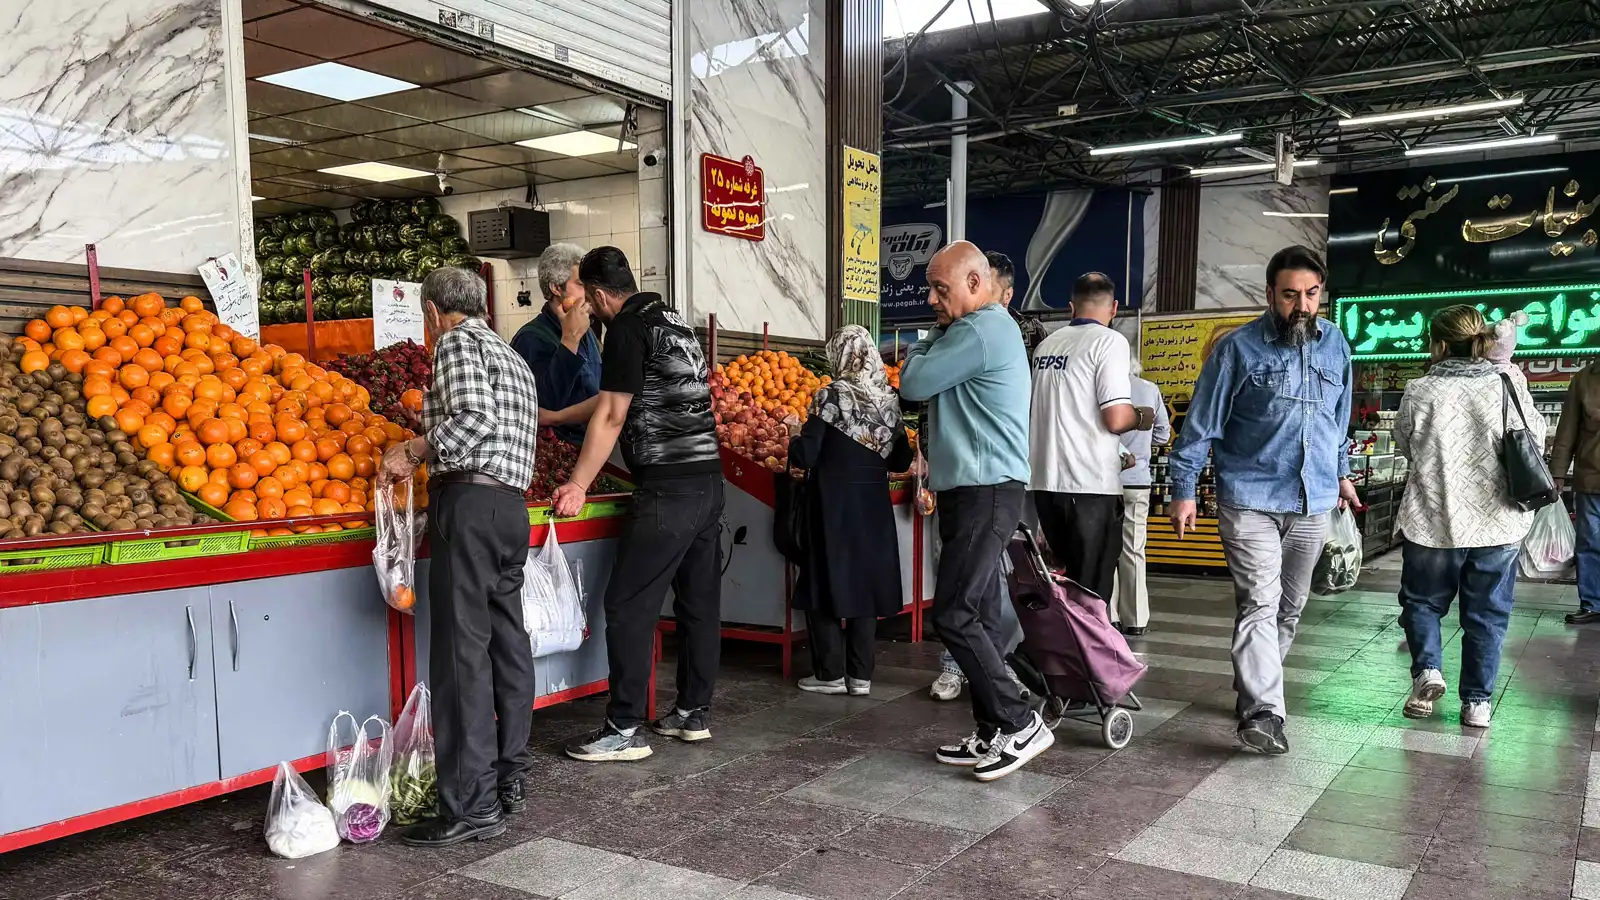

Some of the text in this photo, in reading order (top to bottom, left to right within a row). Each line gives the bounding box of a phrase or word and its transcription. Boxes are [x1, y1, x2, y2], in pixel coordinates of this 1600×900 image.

[847, 153, 865, 171] تحویل
[711, 167, 758, 200] غرفه شماره ۲۵
[711, 197, 759, 229] میوه نمونه
[1374, 175, 1600, 265] بنیات سنتی
[882, 231, 910, 245] egah
[890, 230, 933, 255] پگاه
[895, 282, 914, 297] یعنی
[1148, 322, 1195, 332] عرضه مستقیم
[1345, 303, 1425, 352] پیتزا
[1515, 291, 1600, 346] نواع
[1185, 335, 1198, 344] عسل
[1148, 350, 1192, 360] سراسر کشور
[1161, 365, 1177, 373] درصد
